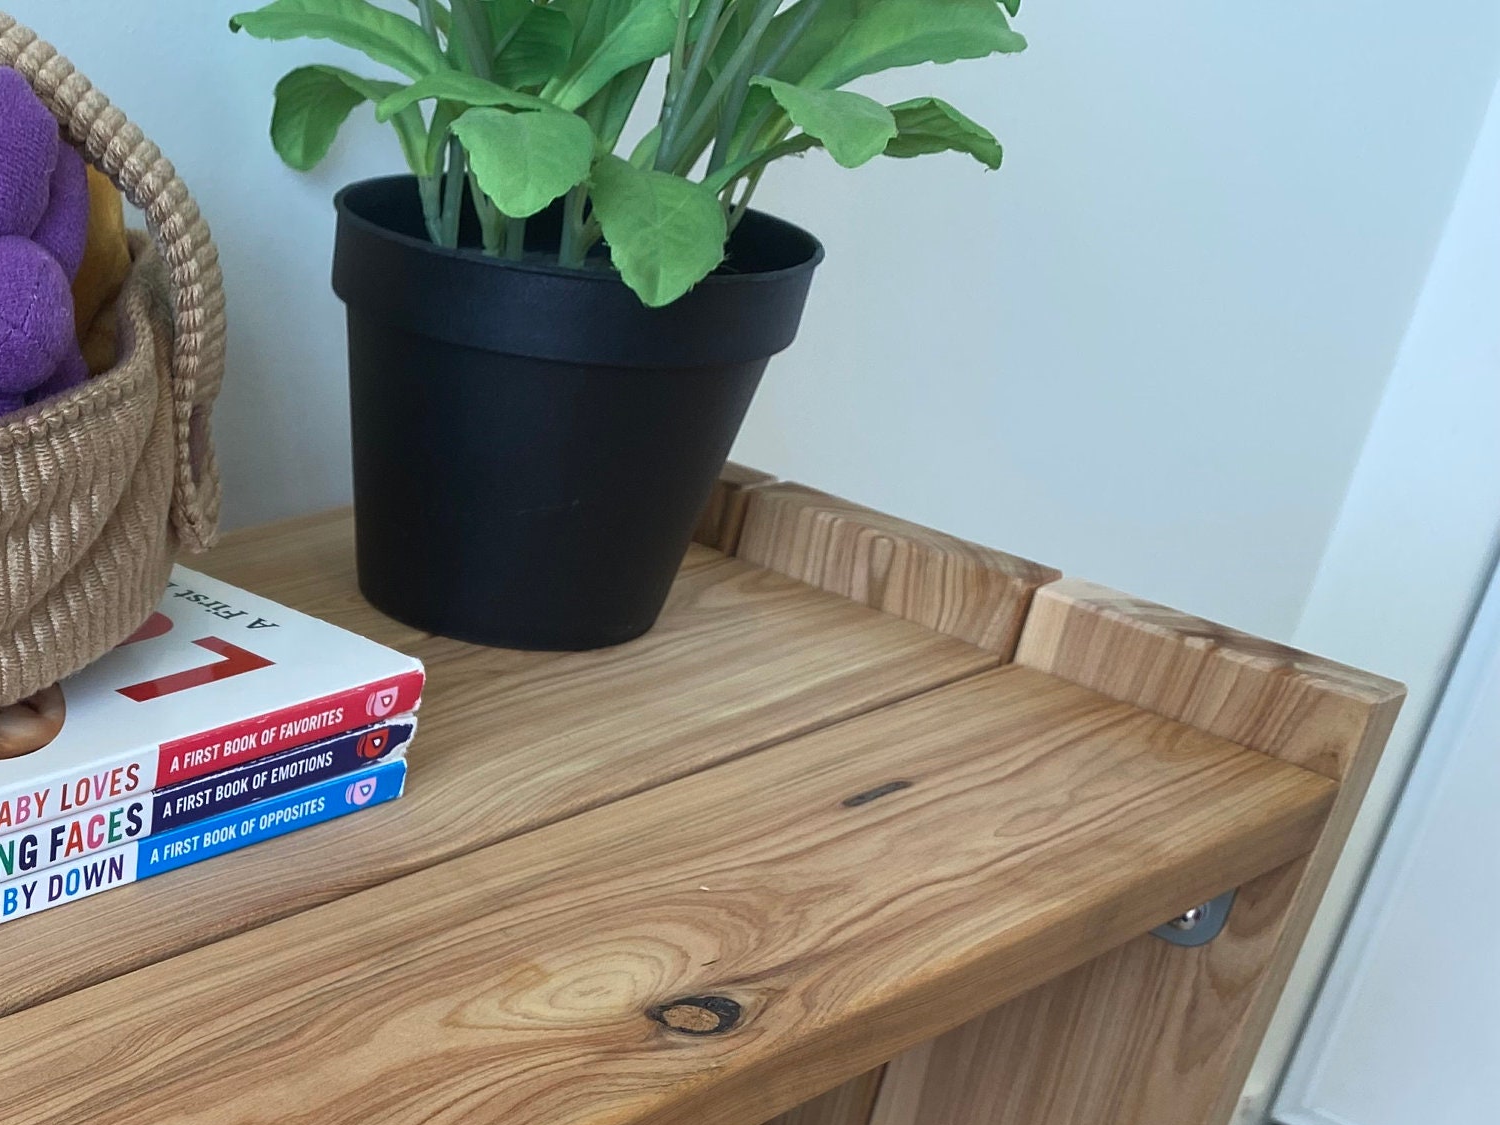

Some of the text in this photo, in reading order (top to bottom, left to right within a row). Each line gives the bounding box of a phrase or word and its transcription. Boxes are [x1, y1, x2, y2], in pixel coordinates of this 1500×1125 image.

[173, 589, 280, 629] A First
[169, 707, 344, 774] A FIRST BOOK OF FAVORITES
[60, 763, 140, 811] LOVES
[162, 751, 333, 819] A FIRST BOOK OF EMOTIONS
[50, 802, 144, 862] FACES
[150, 796, 326, 865] A FIRST BOOK OF OPPOSITES
[48, 854, 124, 902] DOWN
